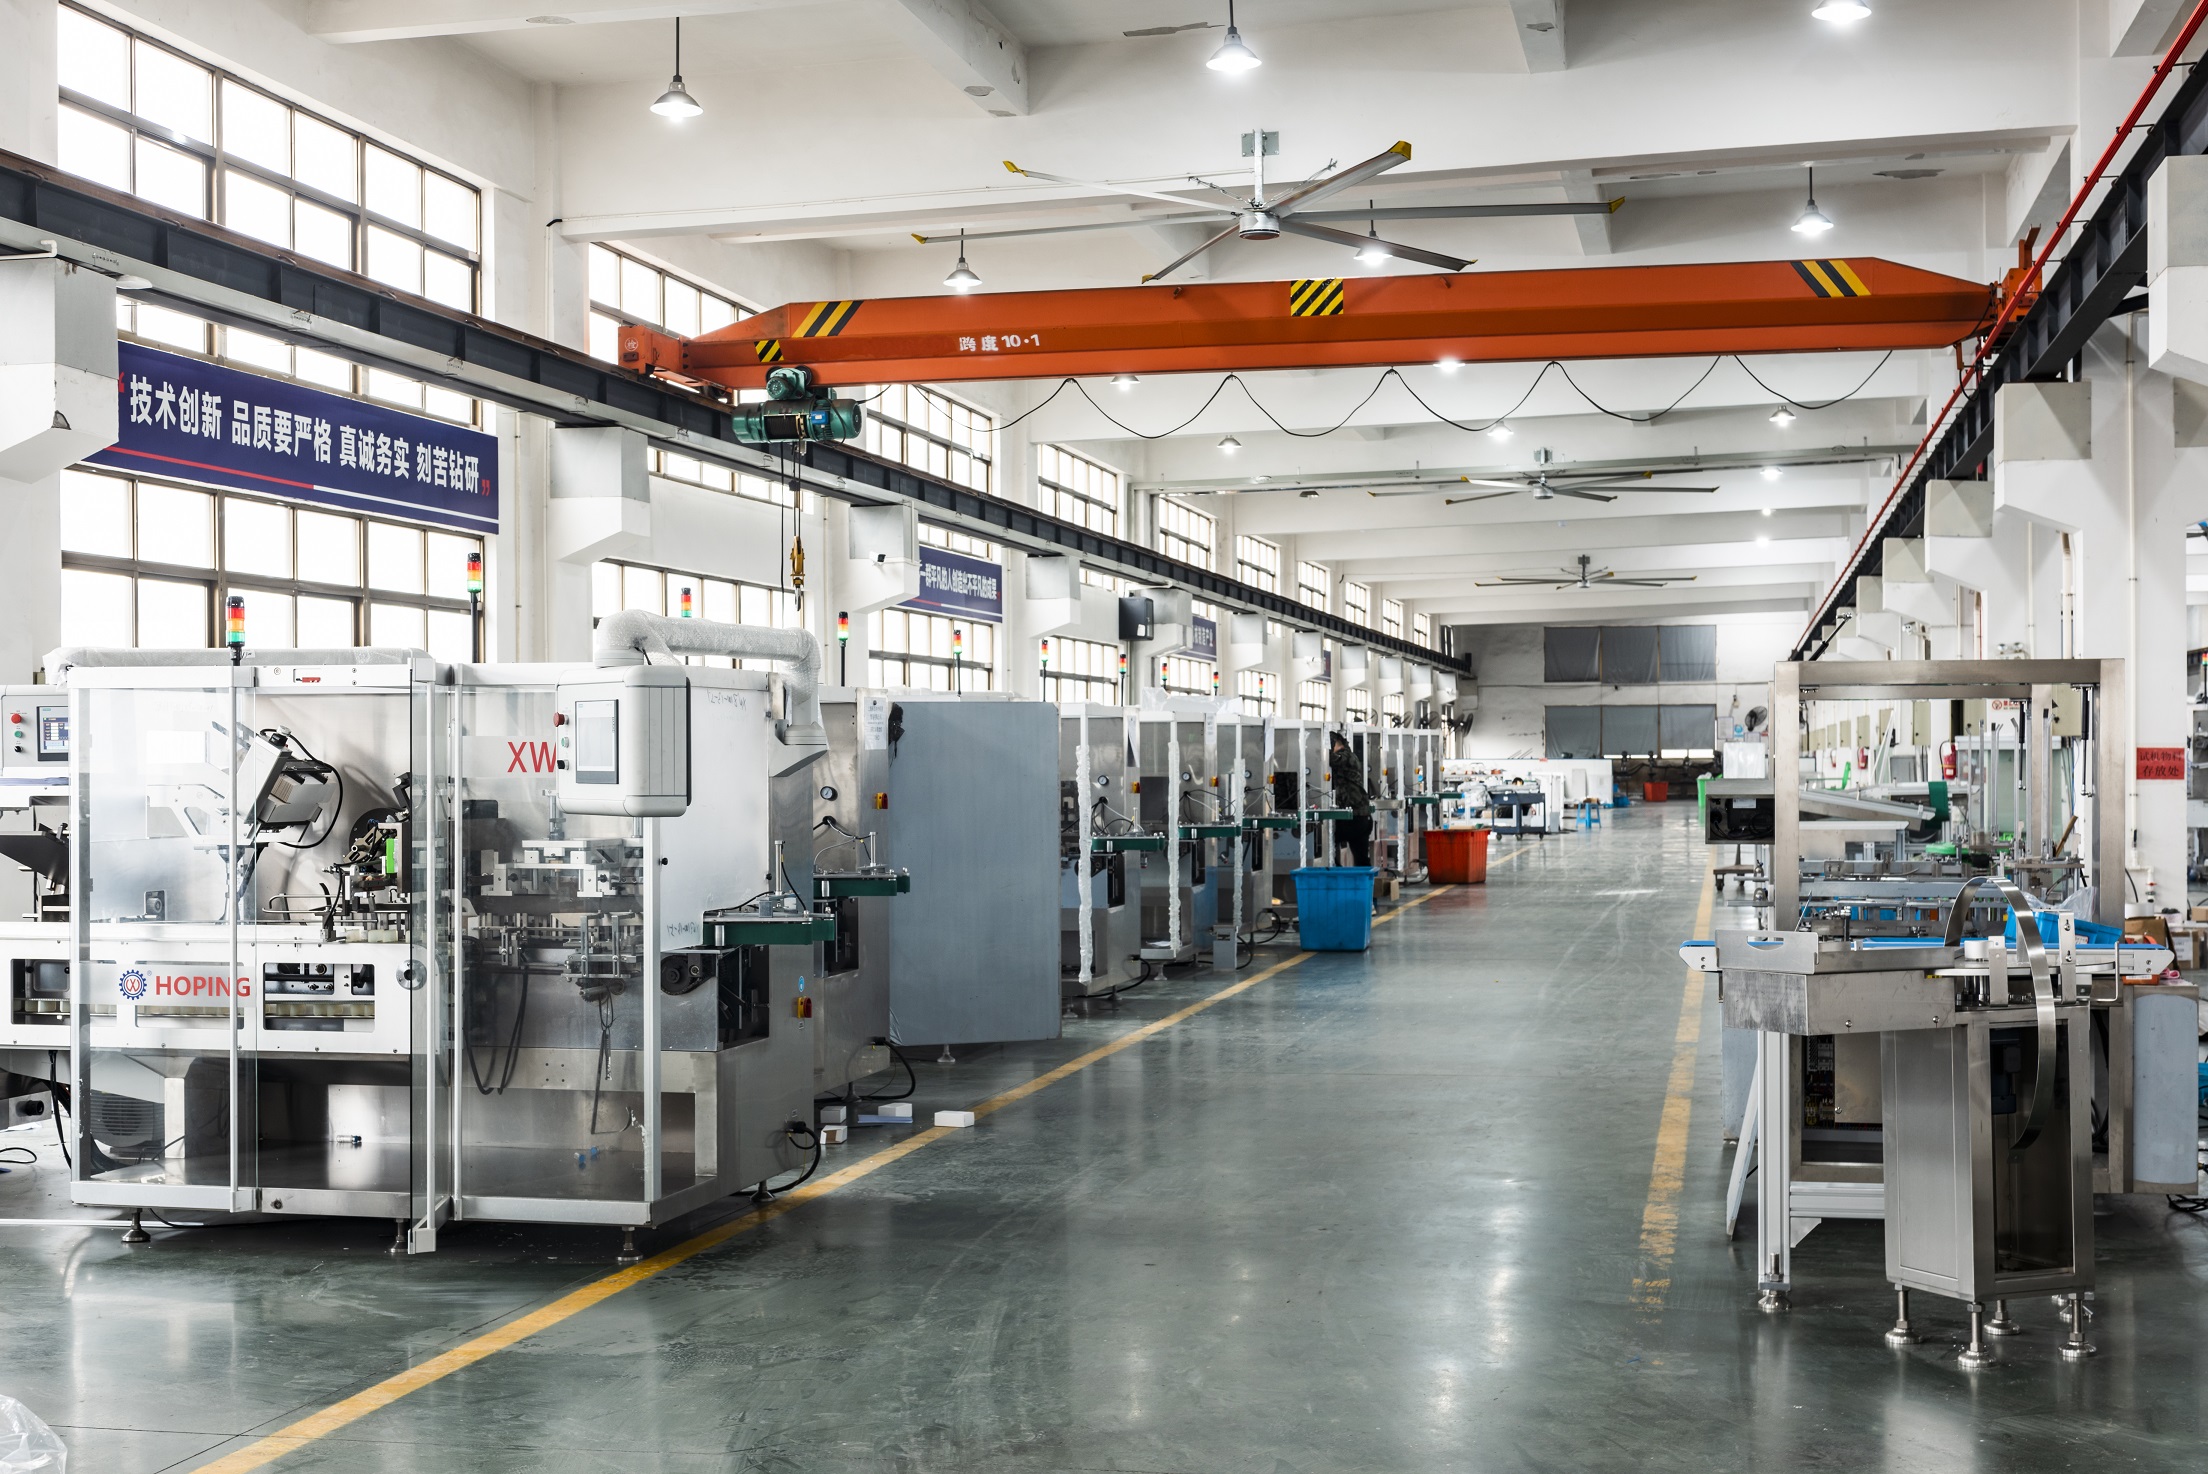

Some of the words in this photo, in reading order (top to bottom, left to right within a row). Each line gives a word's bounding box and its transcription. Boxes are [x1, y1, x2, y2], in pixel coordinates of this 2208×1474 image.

[231, 400, 332, 464] 品质要严格
[339, 424, 410, 479] 真诚务实
[919, 562, 998, 600] 一群平凡的人创造出不平凡的成果
[507, 741, 557, 773] XW
[2143, 765, 2179, 777] 存放处
[155, 975, 251, 997] HOPING
